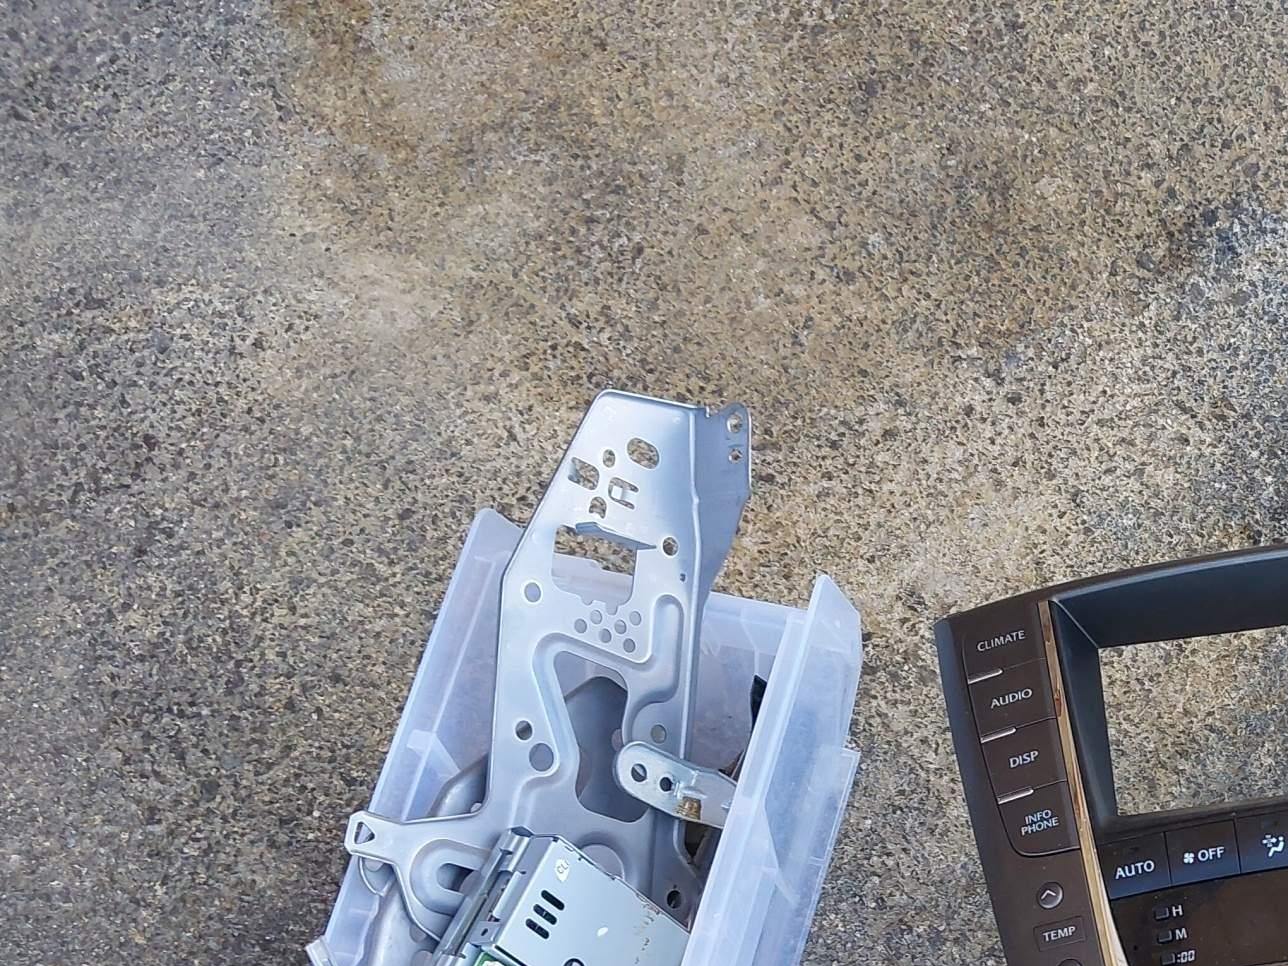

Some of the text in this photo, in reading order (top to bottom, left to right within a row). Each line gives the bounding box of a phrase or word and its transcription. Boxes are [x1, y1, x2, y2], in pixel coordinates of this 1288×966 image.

[976, 630, 1026, 652] CLIMATE
[990, 688, 1033, 709] AUDIO
[1009, 750, 1039, 768] DISP
[1025, 809, 1052, 825] INFO
[1021, 816, 1060, 836] PHONE
[1198, 846, 1225, 862] OFF
[1115, 860, 1155, 880] AUTO
[1172, 904, 1183, 917] H
[1043, 926, 1076, 942] TEMP
[1176, 927, 1188, 940] M
